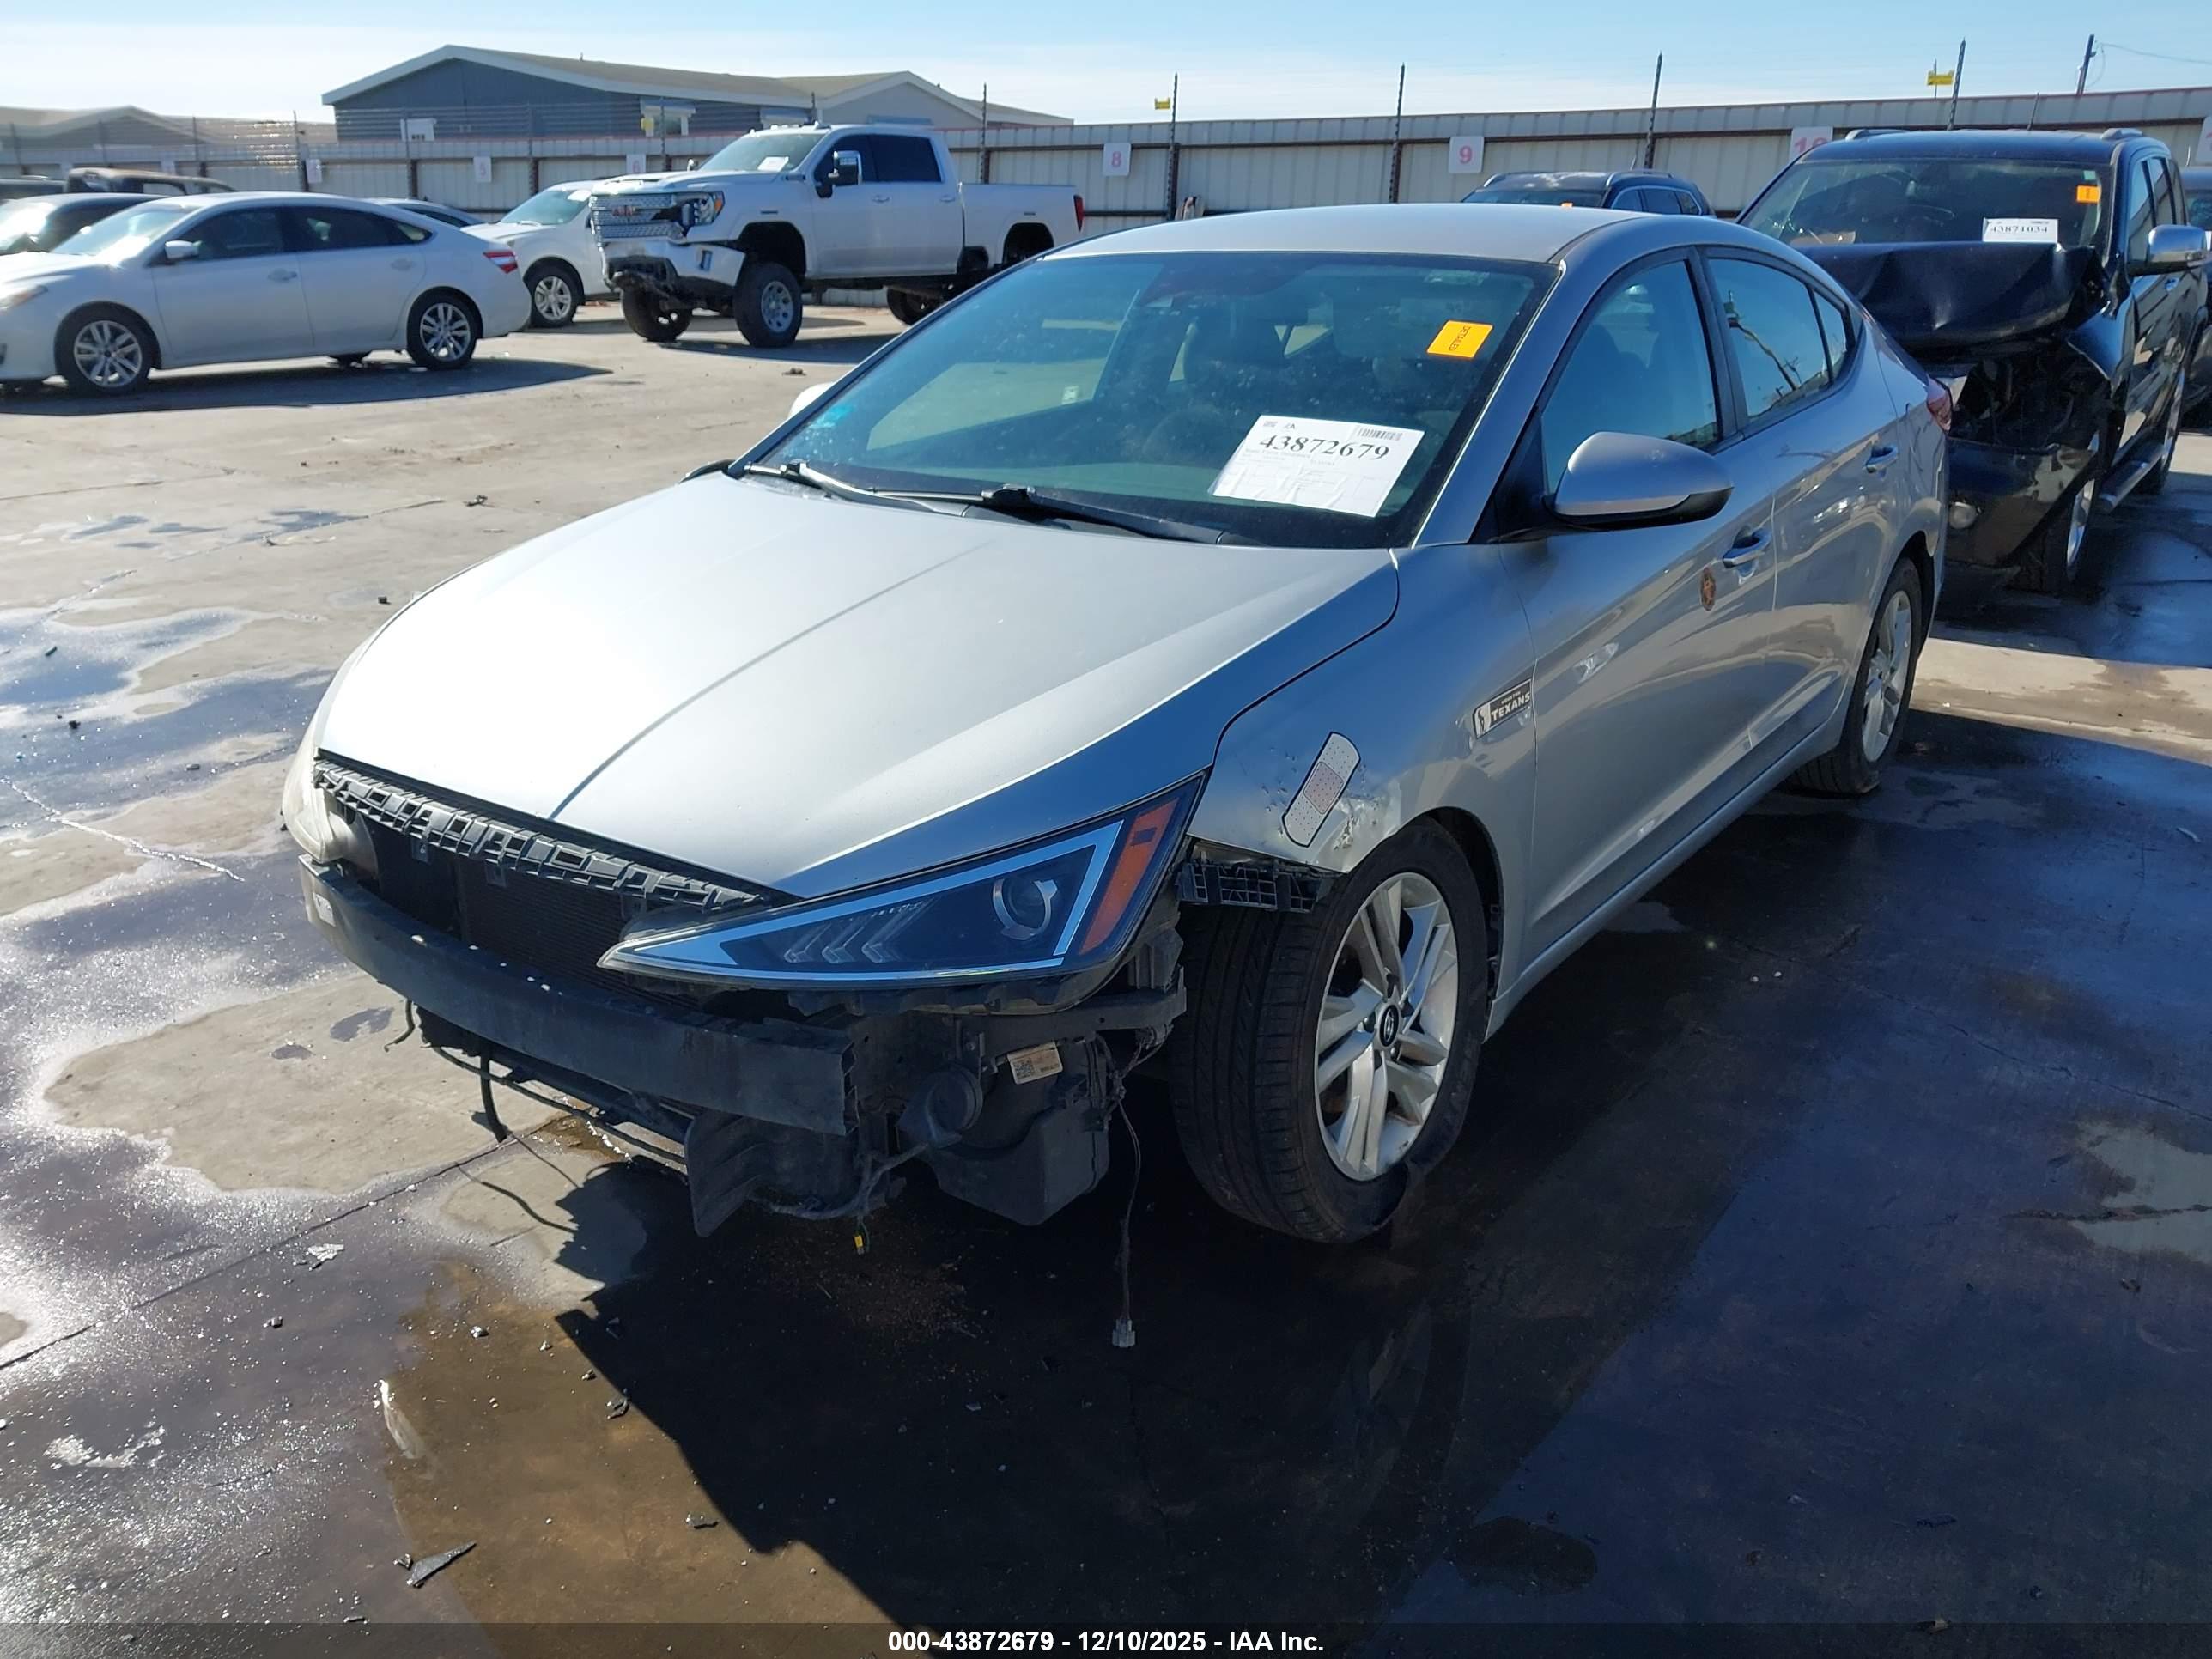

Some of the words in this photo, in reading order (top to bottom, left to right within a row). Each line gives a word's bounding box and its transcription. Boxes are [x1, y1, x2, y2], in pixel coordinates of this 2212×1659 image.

[1111, 150, 1121, 168] 8
[1460, 145, 1472, 164] 9
[1260, 434, 1389, 460] 43872679
[1491, 692, 1530, 721] TEXANS
